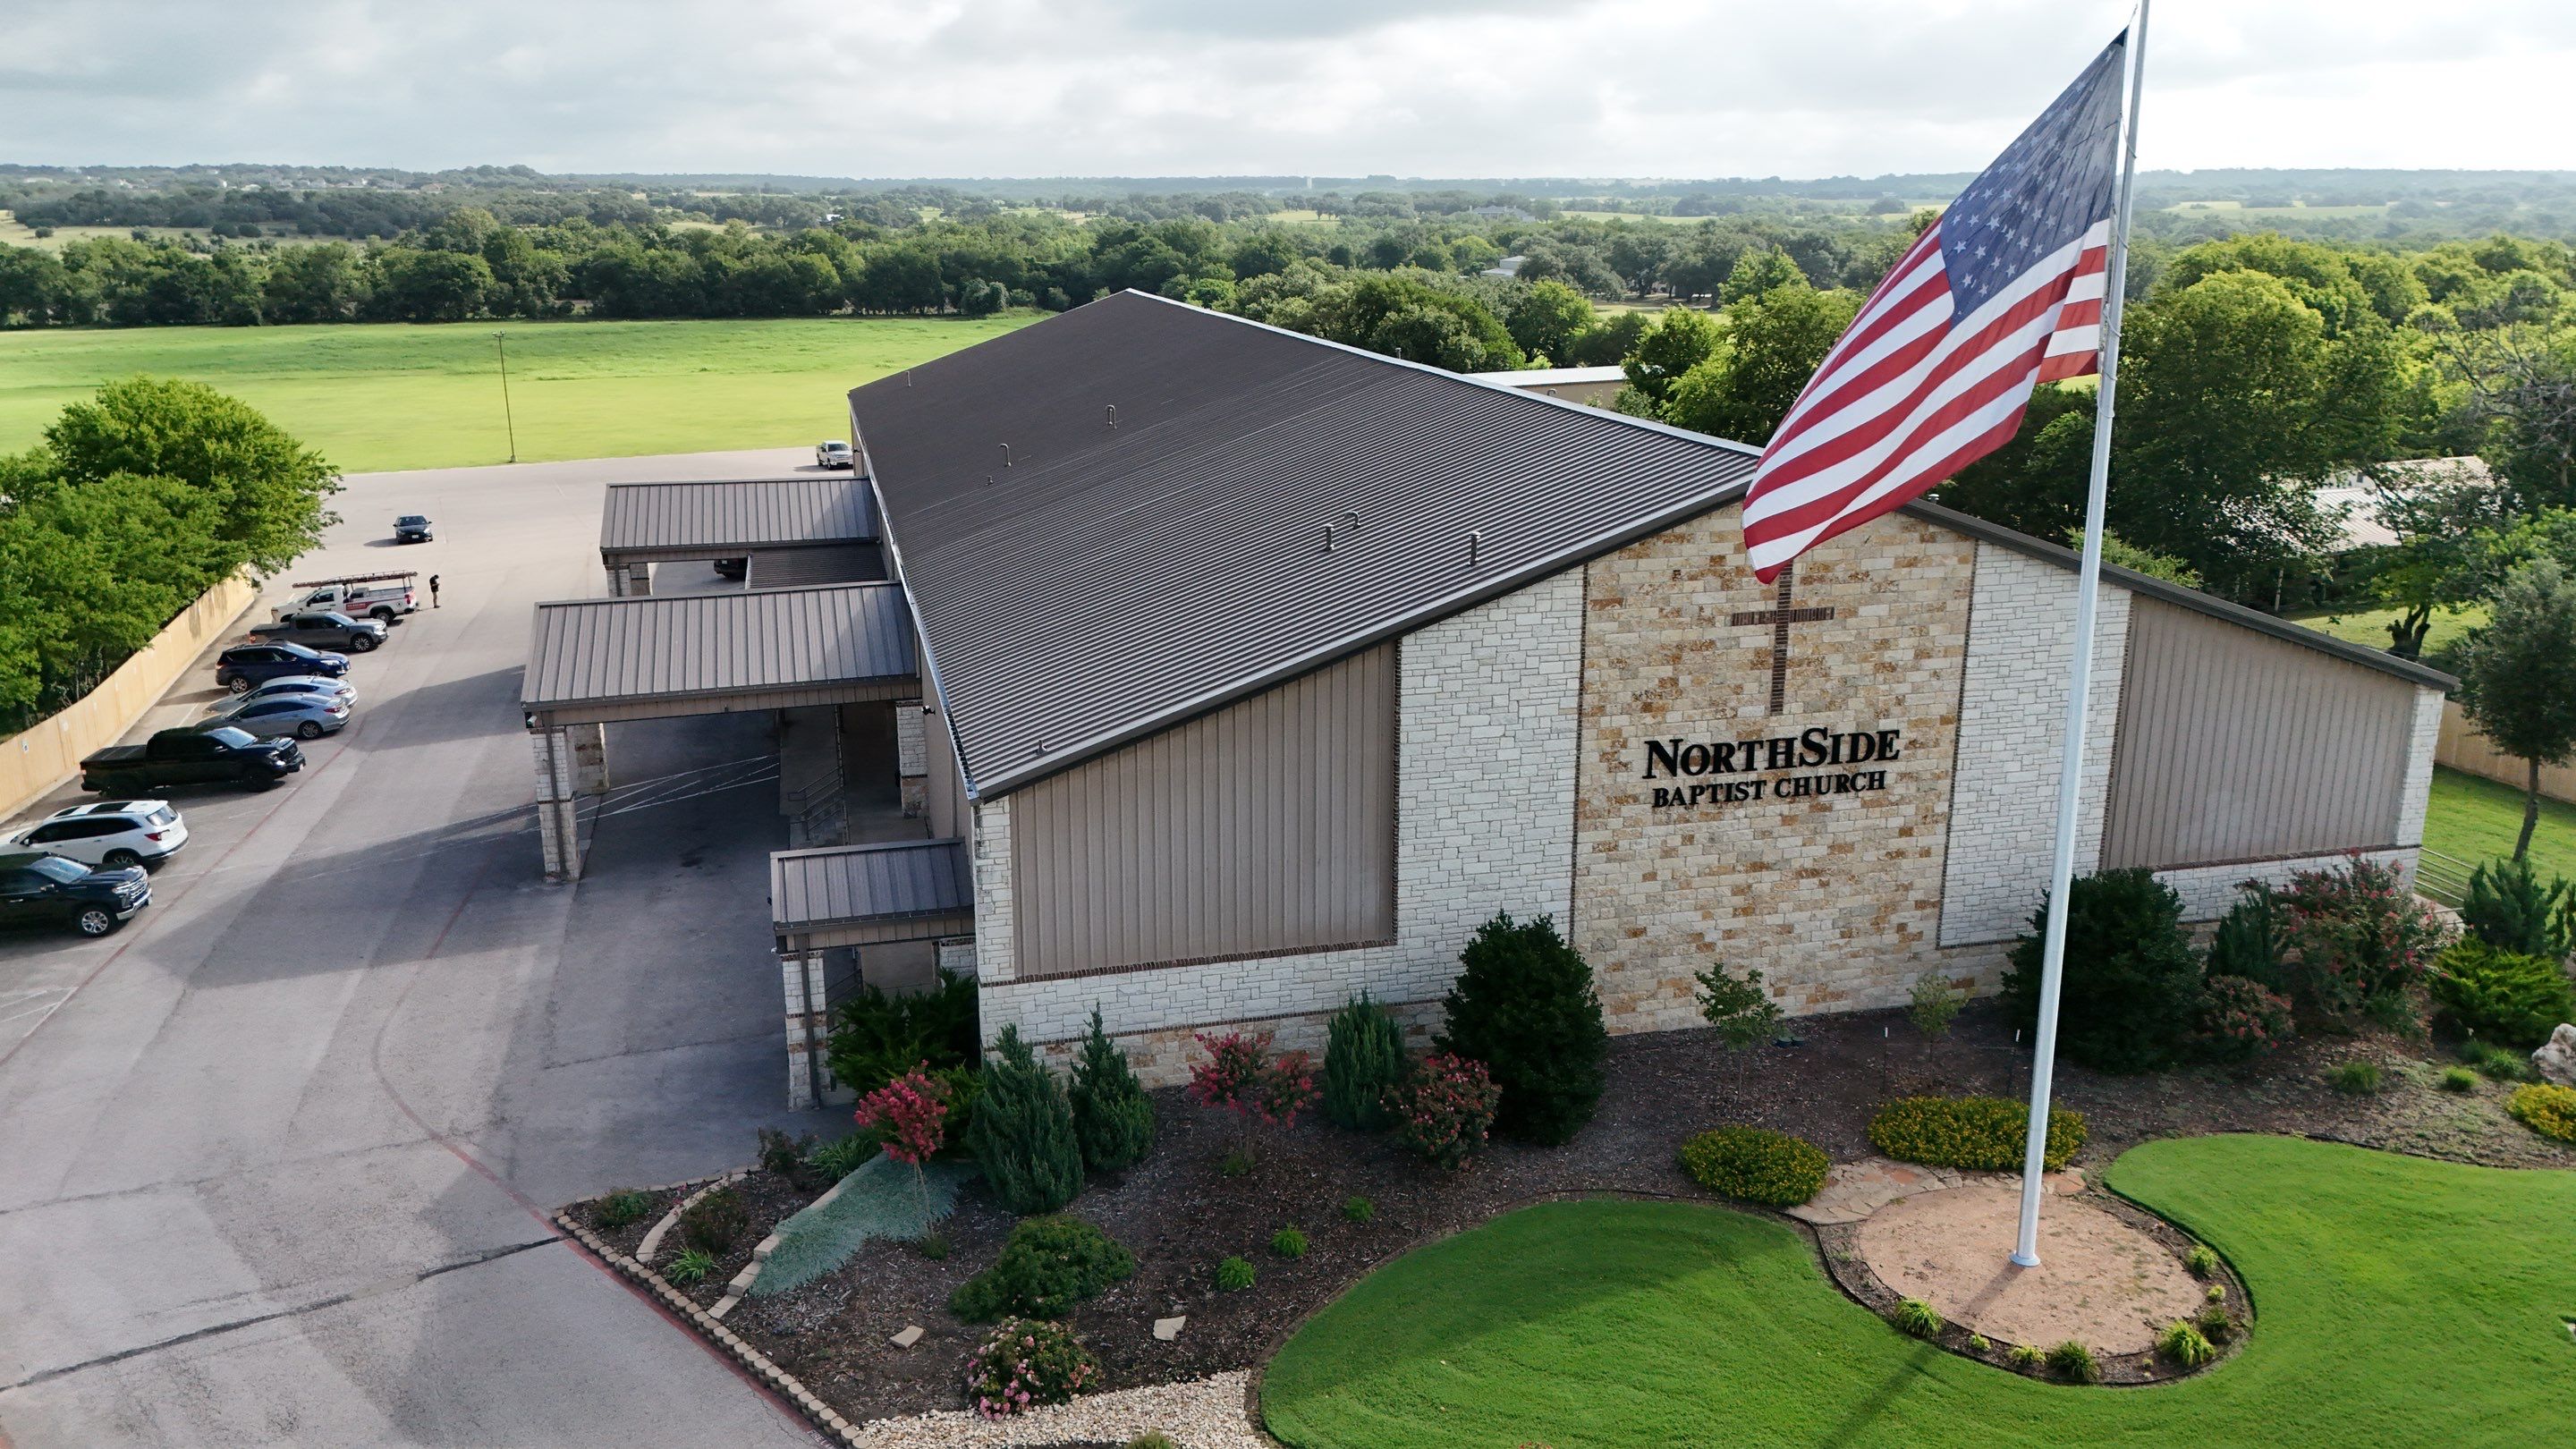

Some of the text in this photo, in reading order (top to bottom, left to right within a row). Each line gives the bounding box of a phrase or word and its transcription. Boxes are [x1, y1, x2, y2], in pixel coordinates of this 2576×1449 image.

[1652, 770, 1887, 809] BAPTIST CHURCH
[807, 1429, 825, 1443] FIRE
